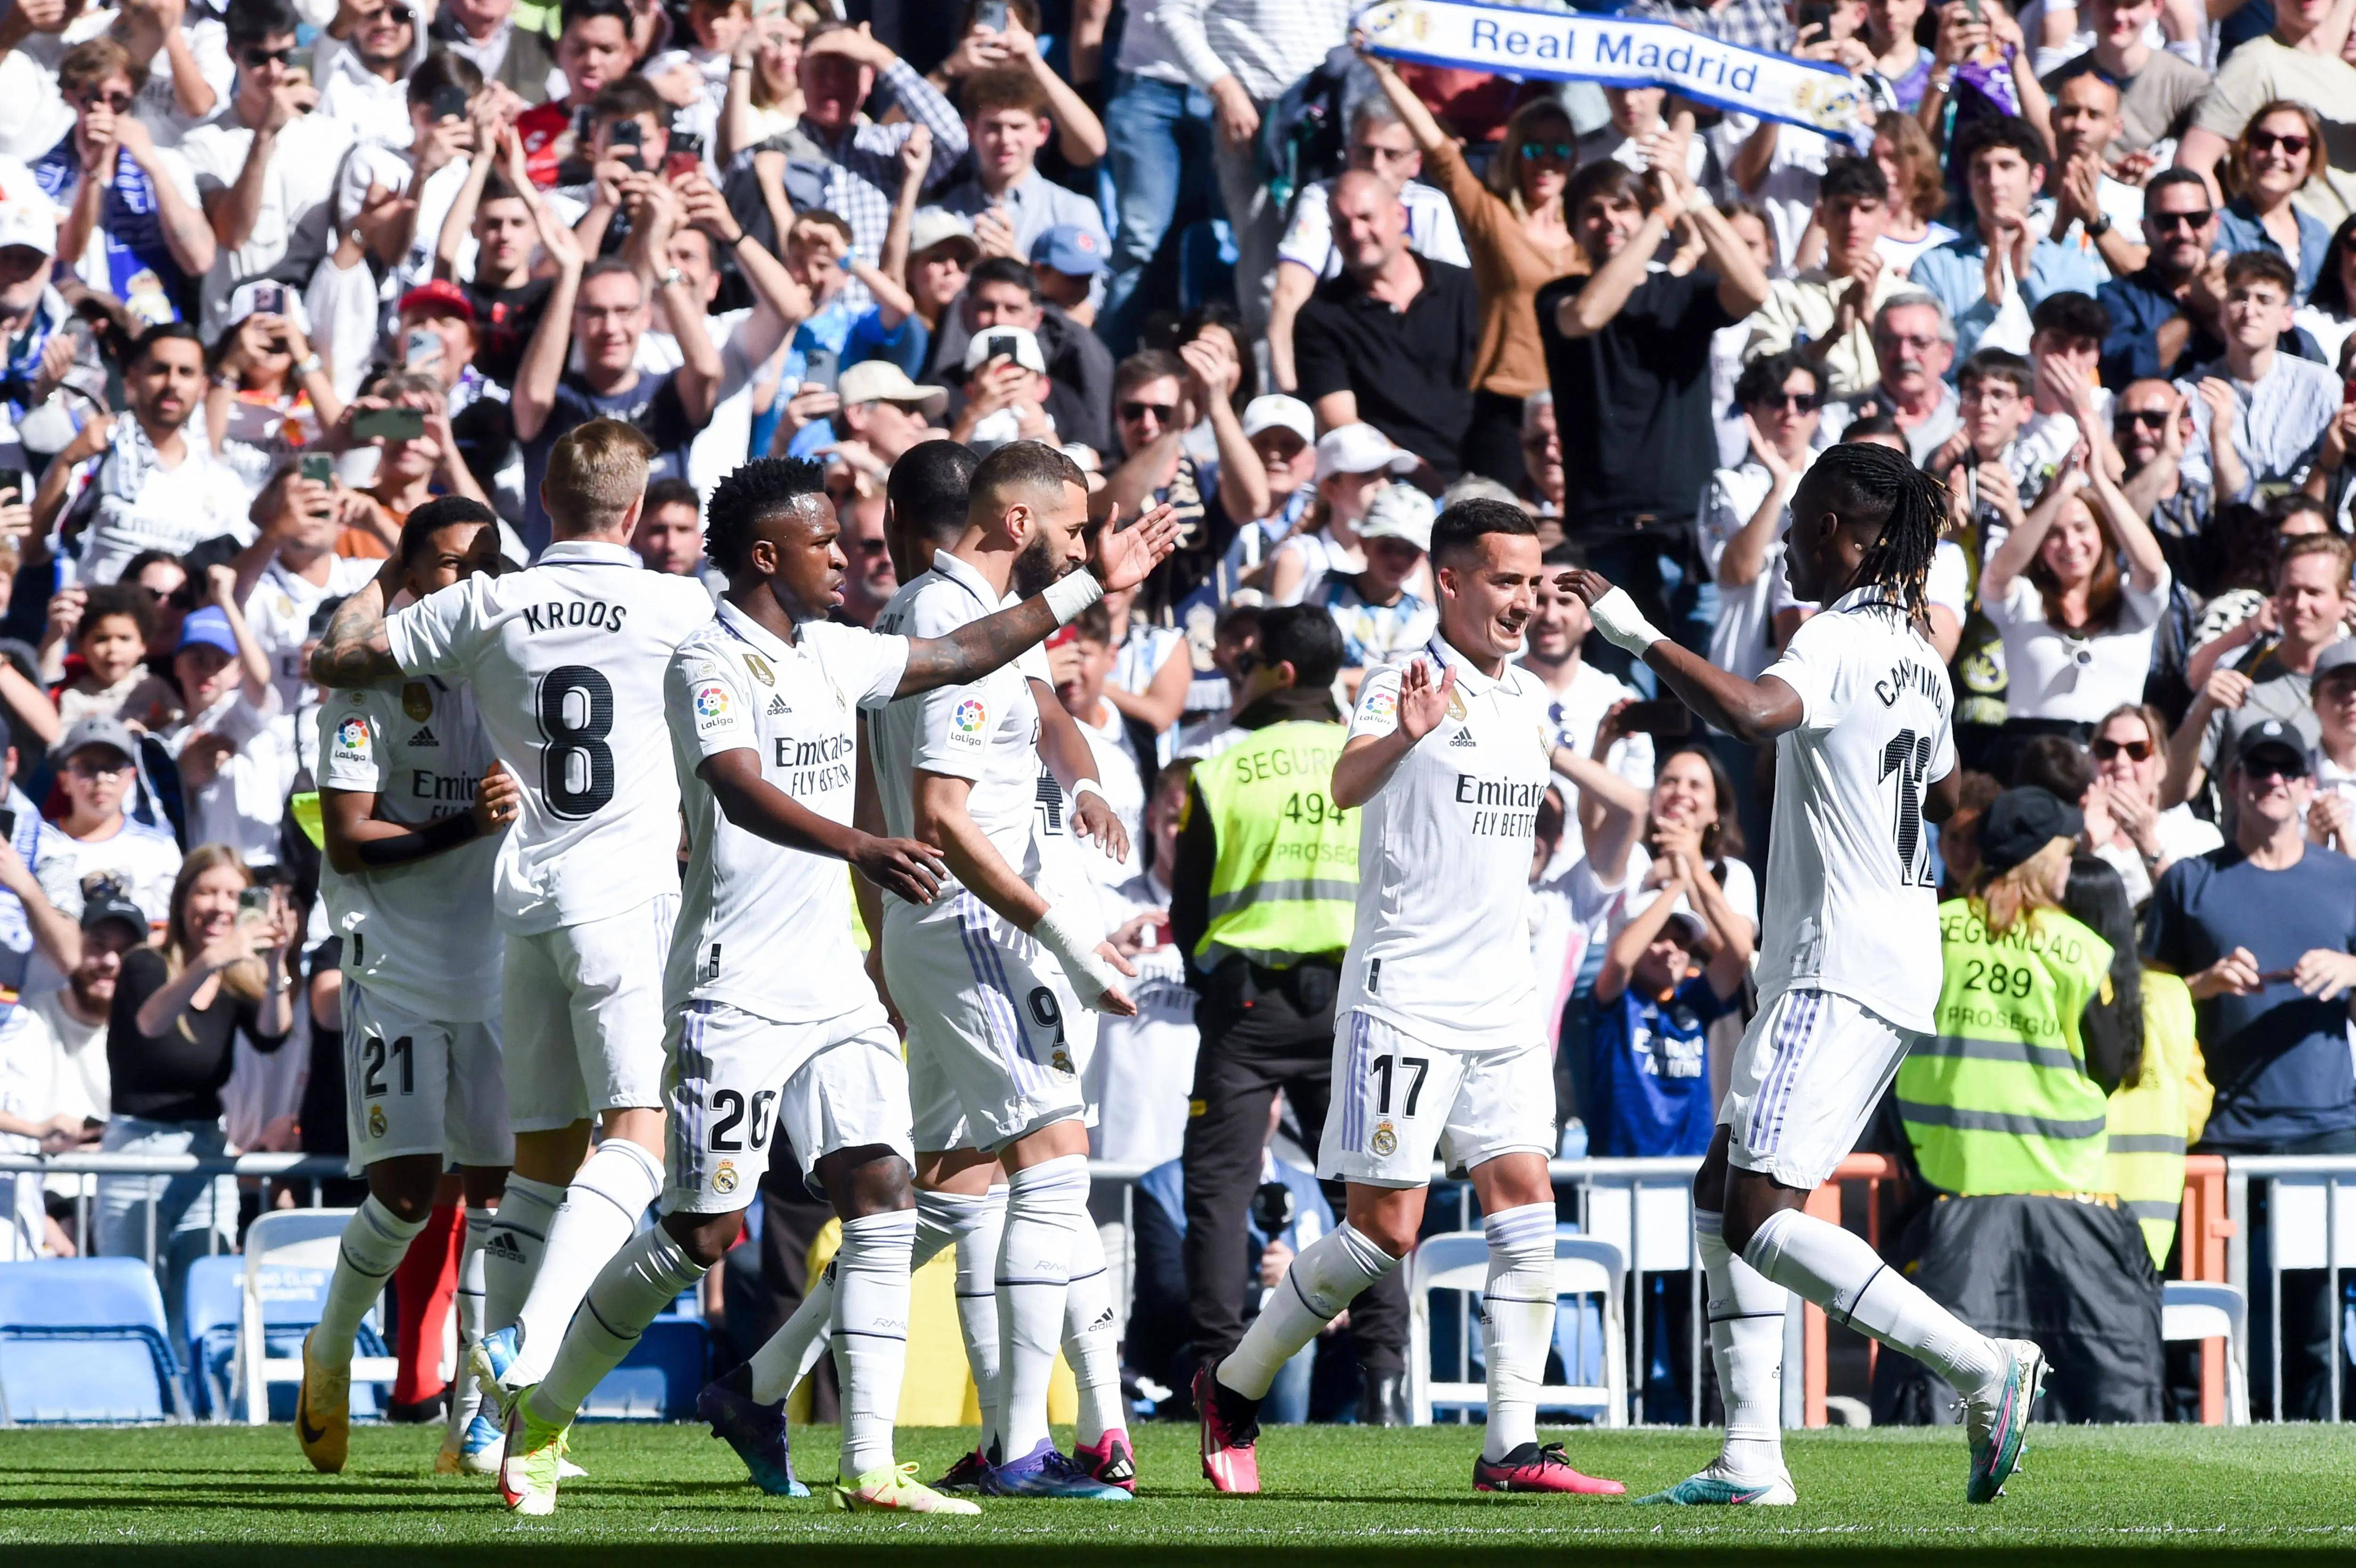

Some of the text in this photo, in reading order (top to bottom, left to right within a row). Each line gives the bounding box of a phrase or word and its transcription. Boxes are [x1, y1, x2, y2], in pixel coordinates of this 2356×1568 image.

[1471, 18, 1759, 94] Real Madrid
[521, 601, 627, 636] KROOS
[701, 717, 734, 730] LaLiga
[767, 705, 793, 716] adidas
[1359, 714, 1391, 725] LaLiga
[408, 738, 440, 747] adidas
[535, 665, 614, 821] 8
[950, 731, 982, 746] LaLiga
[1449, 738, 1477, 747] adidas
[335, 749, 366, 762] LaLiga
[1236, 748, 1342, 784] SEGURI
[791, 771, 816, 797] FLY
[1285, 792, 1345, 826] 494
[1472, 811, 1497, 836] FLY
[1939, 916, 2082, 964] EGURIDAD
[1963, 959, 2032, 999] 289
[1026, 986, 1065, 1047] 9
[362, 1036, 414, 1100] 21
[1370, 1054, 1430, 1119] 17
[708, 1088, 777, 1153] 20
[1034, 1260, 1068, 1273] RM
[873, 1318, 908, 1331] RM
